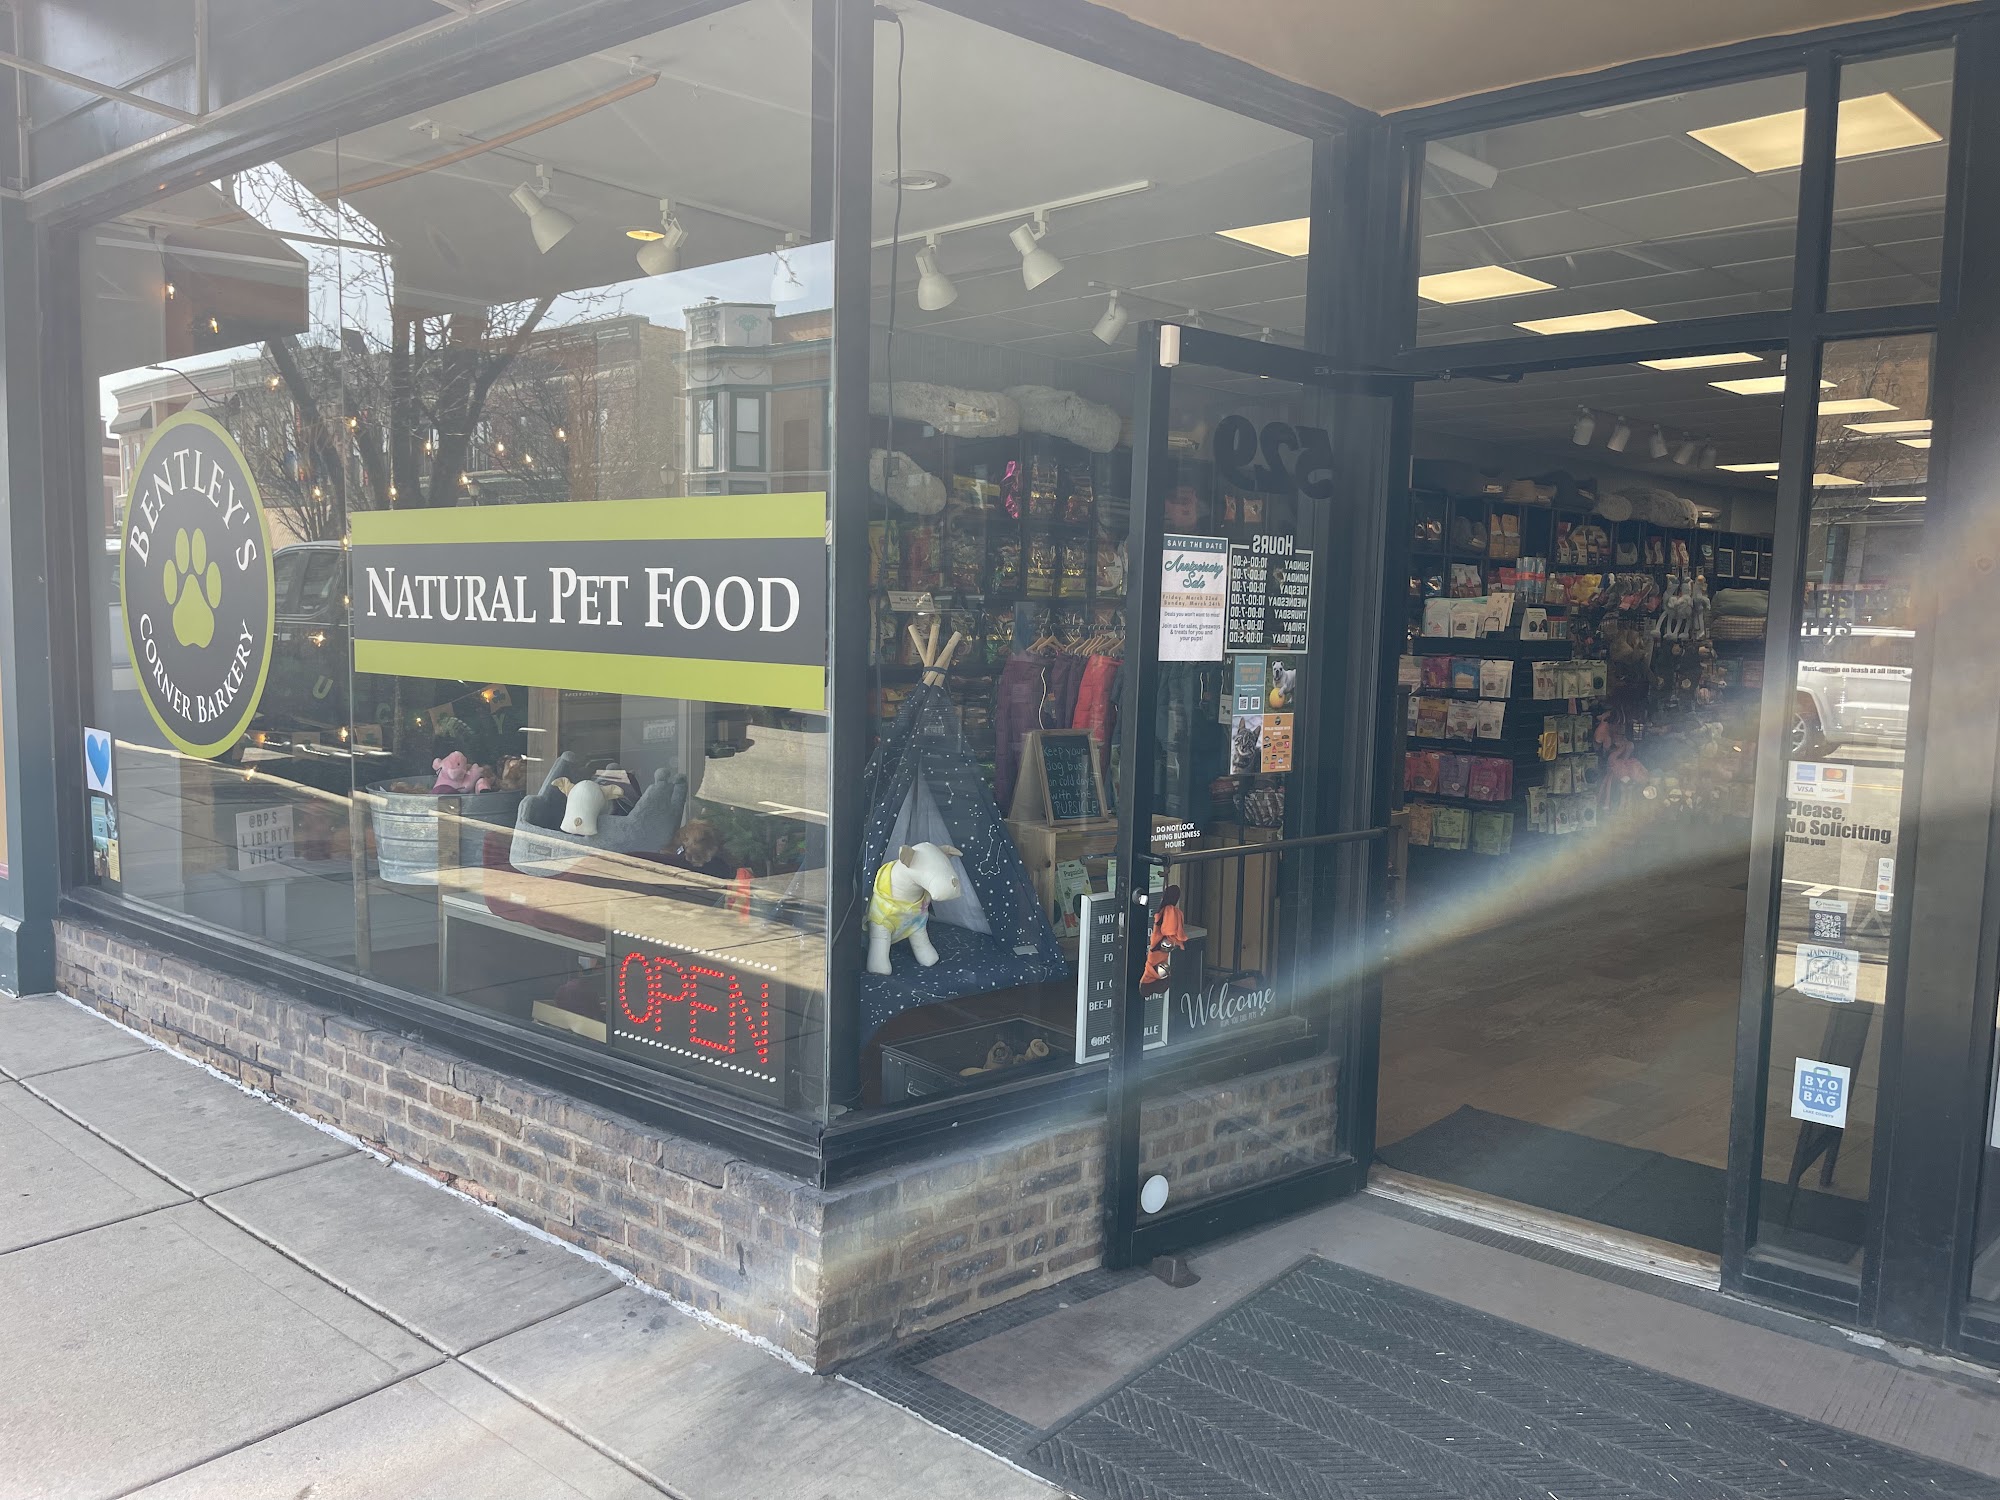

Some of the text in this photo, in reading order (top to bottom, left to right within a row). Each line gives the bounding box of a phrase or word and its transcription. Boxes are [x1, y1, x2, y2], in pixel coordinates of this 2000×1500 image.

[130, 448, 257, 571] BENTLEY'S
[1167, 540, 1223, 550] SAVE THE DATE
[140, 613, 254, 723] CORNER BARKERY
[1044, 746, 1086, 760] Keep your
[1047, 761, 1088, 776] dog busy
[1049, 775, 1095, 789] on cold days
[1051, 789, 1091, 800] with the
[1788, 801, 1846, 822] Please,
[1167, 824, 1180, 832] NOT
[1179, 822, 1195, 831] LOCK
[1787, 817, 1892, 844] No Soliciting
[242, 827, 290, 848] LIBERTY
[1151, 830, 1200, 842] DURING BUSINESS
[1785, 835, 1826, 846] Thank you
[1164, 840, 1185, 849] HOURS
[1098, 913, 1116, 924] WHY
[619, 952, 768, 1064] OPEN
[1180, 982, 1275, 1029] Welcome
[1805, 1075, 1838, 1091] BYO
[1803, 1091, 1836, 1107] BAG
